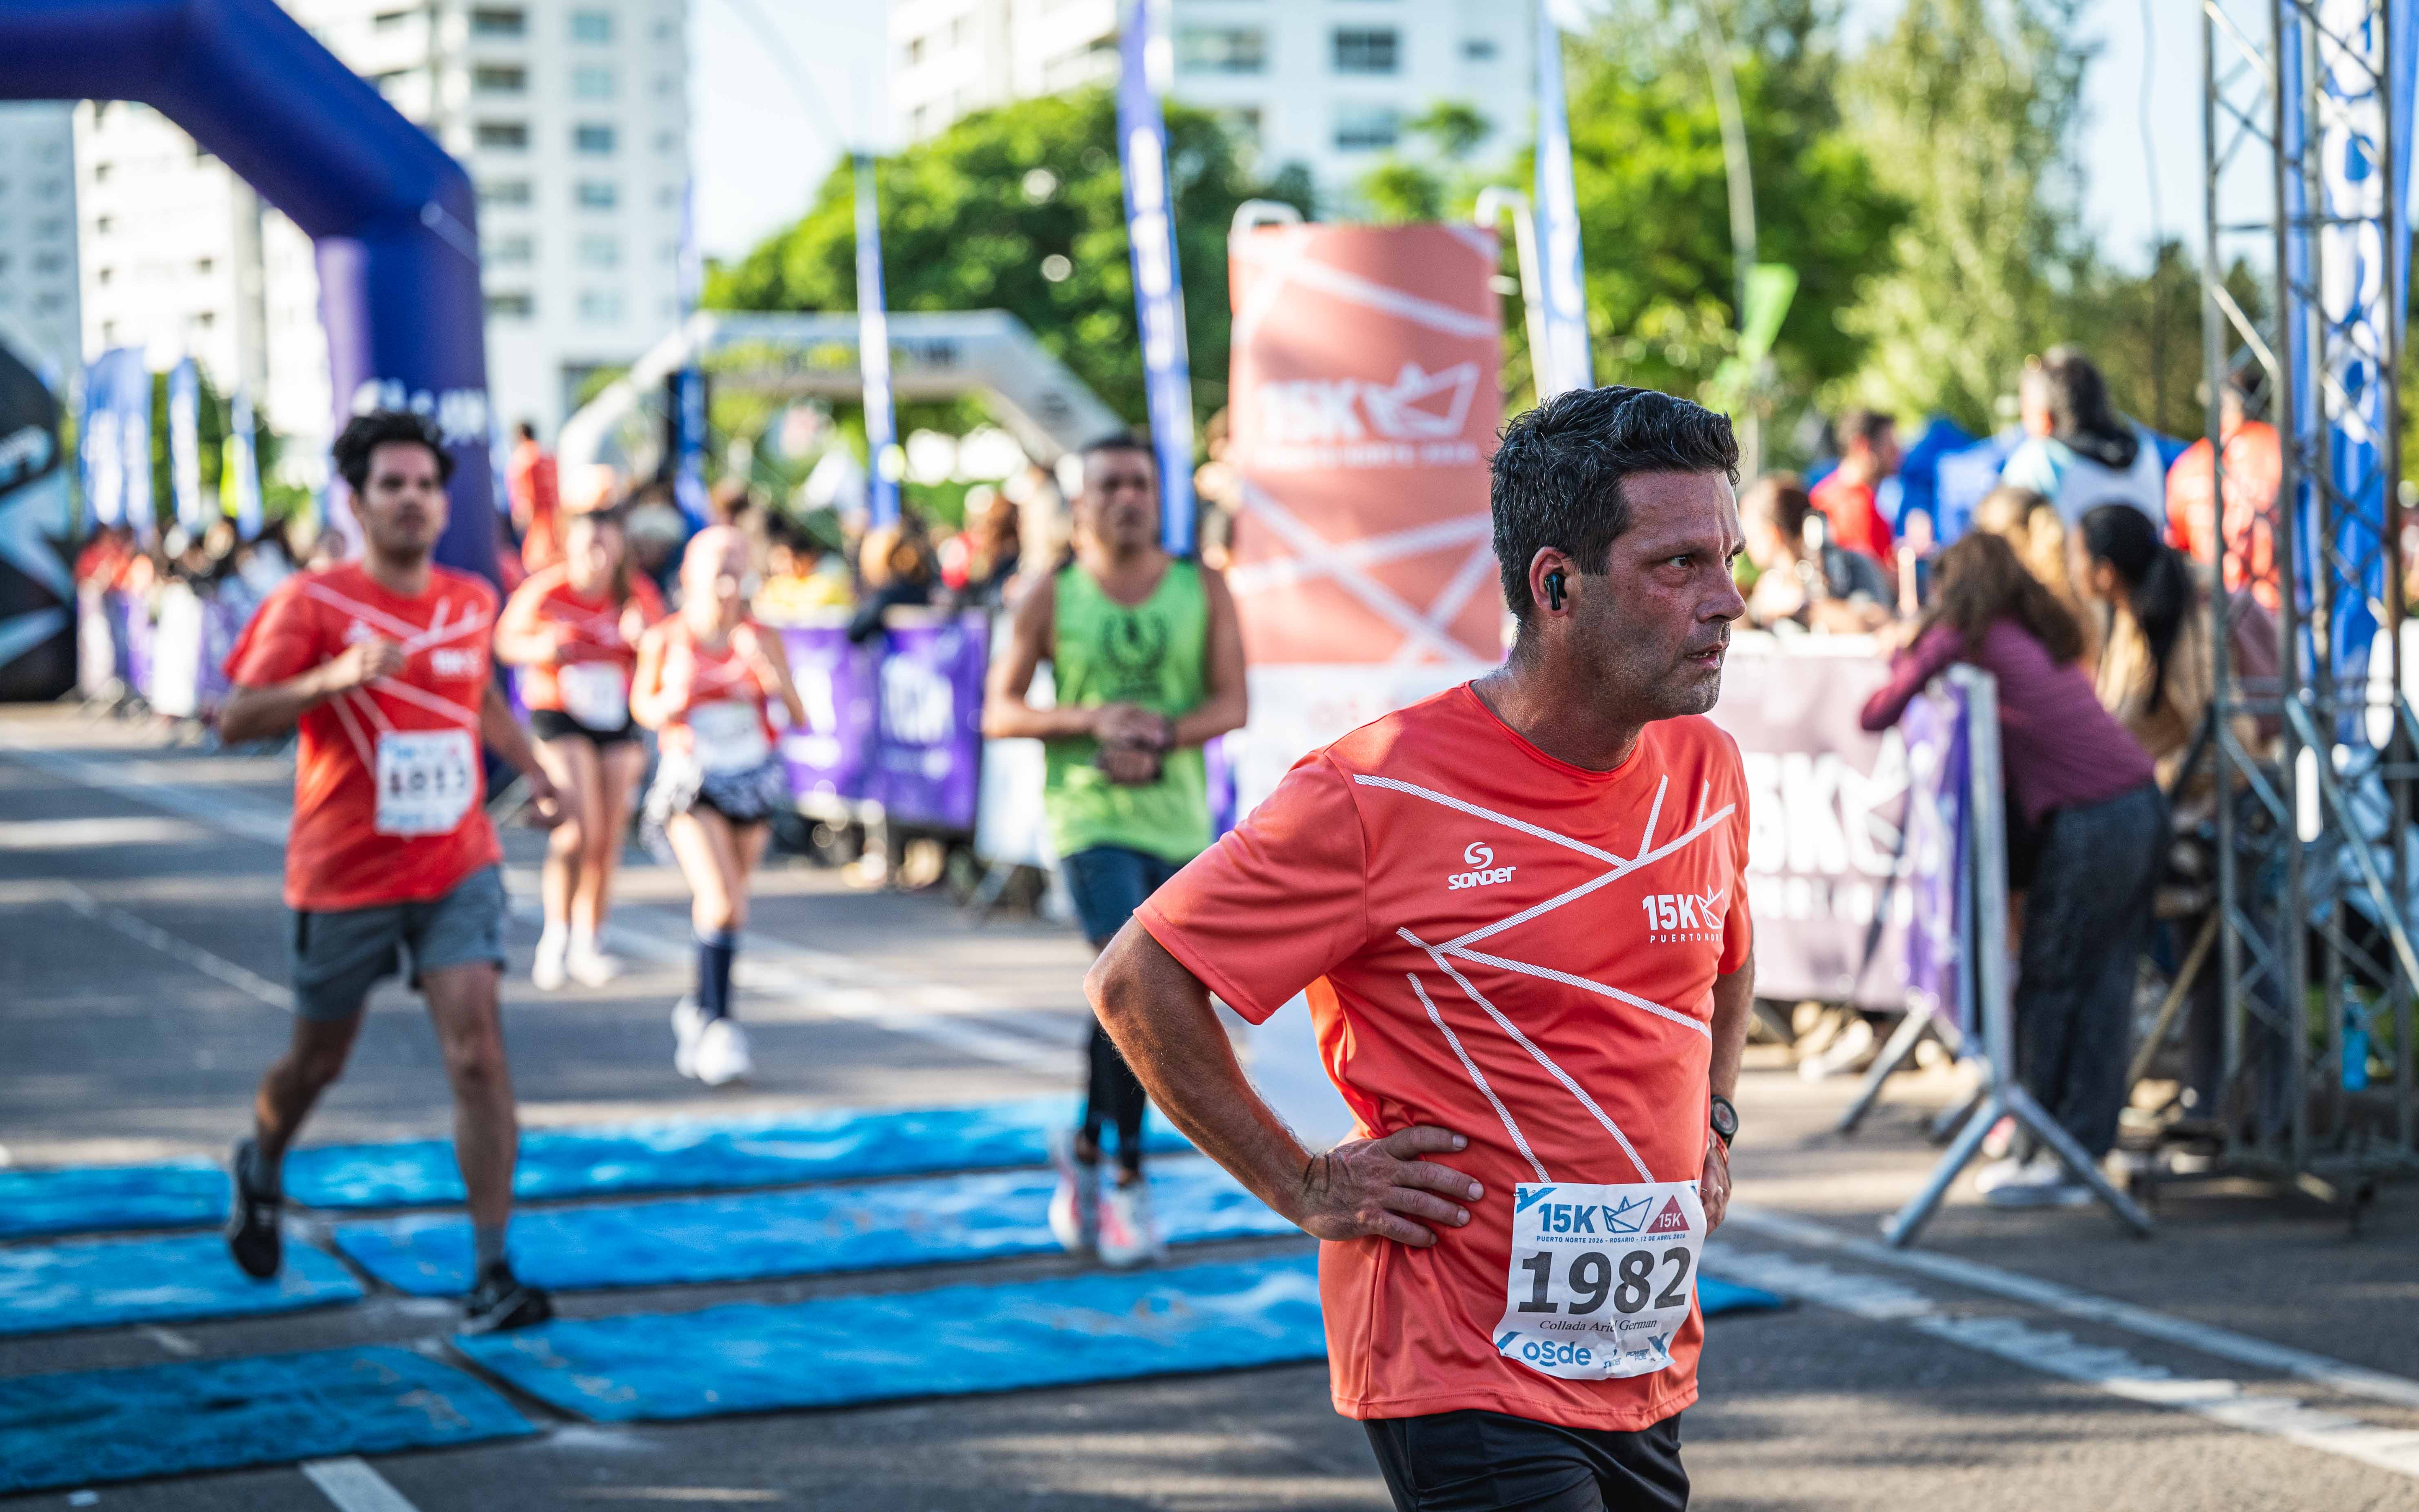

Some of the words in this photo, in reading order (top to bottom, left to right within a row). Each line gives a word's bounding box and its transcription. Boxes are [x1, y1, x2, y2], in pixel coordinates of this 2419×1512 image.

[1642, 894, 1699, 930] 15K
[1650, 933, 1701, 943] PUERTO
[1538, 1203, 1598, 1233] 15K
[1658, 1212, 1682, 1227] 15K
[1518, 1247, 1691, 1315] 1982
[1539, 1320, 1586, 1330] Collada
[1619, 1319, 1657, 1331] German
[1523, 1341, 1592, 1366] osde
